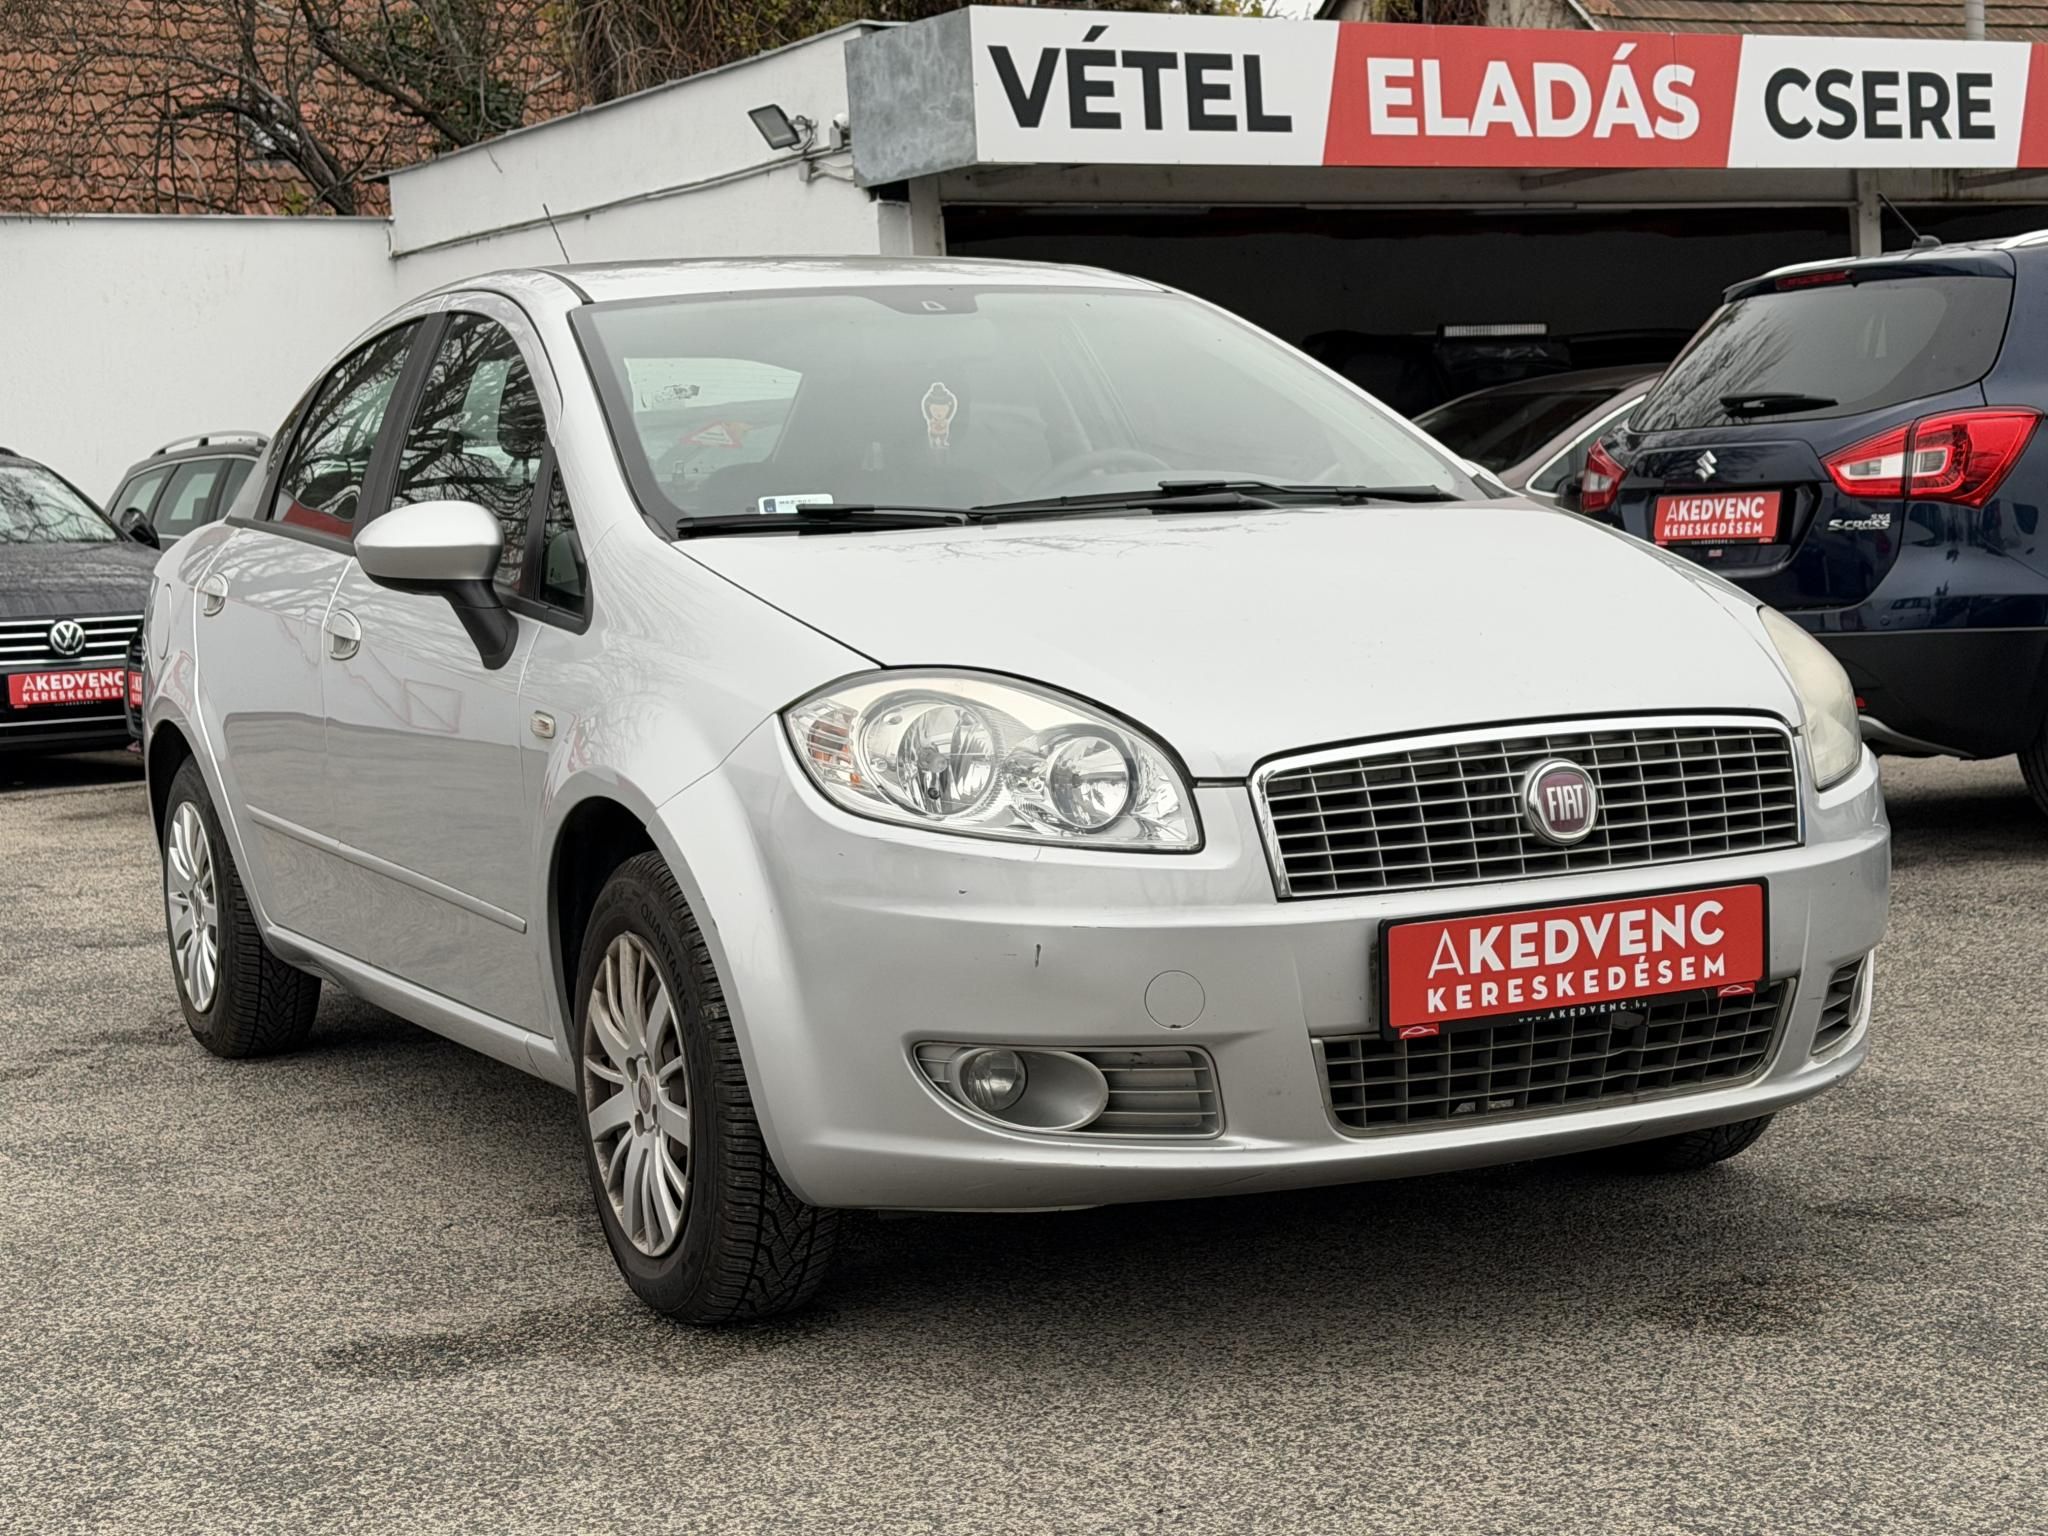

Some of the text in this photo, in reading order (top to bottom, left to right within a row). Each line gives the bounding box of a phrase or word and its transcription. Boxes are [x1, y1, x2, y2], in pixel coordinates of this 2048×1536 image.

[987, 25, 1996, 140] VÉTEL ELADÁS CSERE
[1663, 518, 1764, 537] KERESKEDÉSEM
[1666, 496, 1765, 523] AKEDVENC
[22, 685, 124, 702] KERESKEDÉSE
[1545, 783, 1584, 822] FIAT
[1427, 899, 1725, 979] AKEDVENC
[640, 903, 690, 1016] QUARTARIS
[1426, 954, 1726, 1014] KERESKEDÉSEM
[1517, 999, 1649, 1024] www.AKEDVENC.hu
